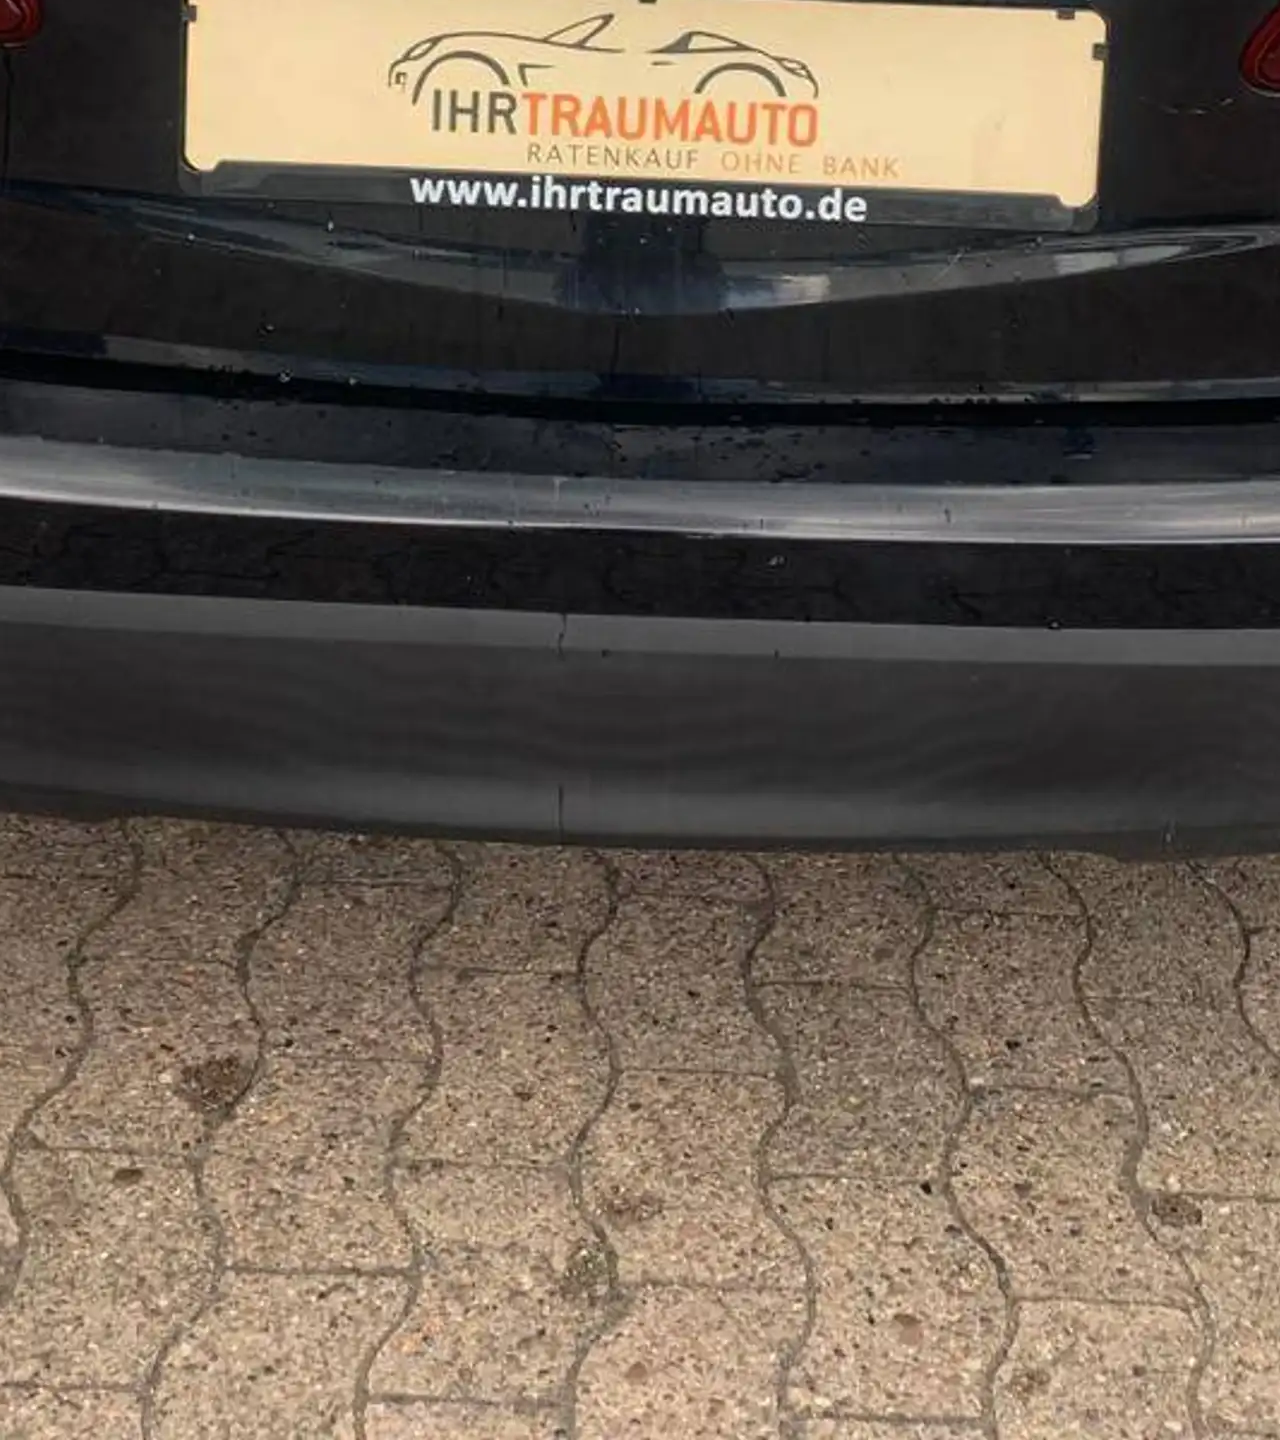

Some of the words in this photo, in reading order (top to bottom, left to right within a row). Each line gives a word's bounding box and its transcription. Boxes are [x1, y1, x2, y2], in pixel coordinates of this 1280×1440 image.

[526, 142, 700, 170] RATENKAUF
[721, 149, 803, 175] OHNE
[823, 155, 900, 179] BANK
[409, 174, 868, 223] www.ihrtraumauto.de
